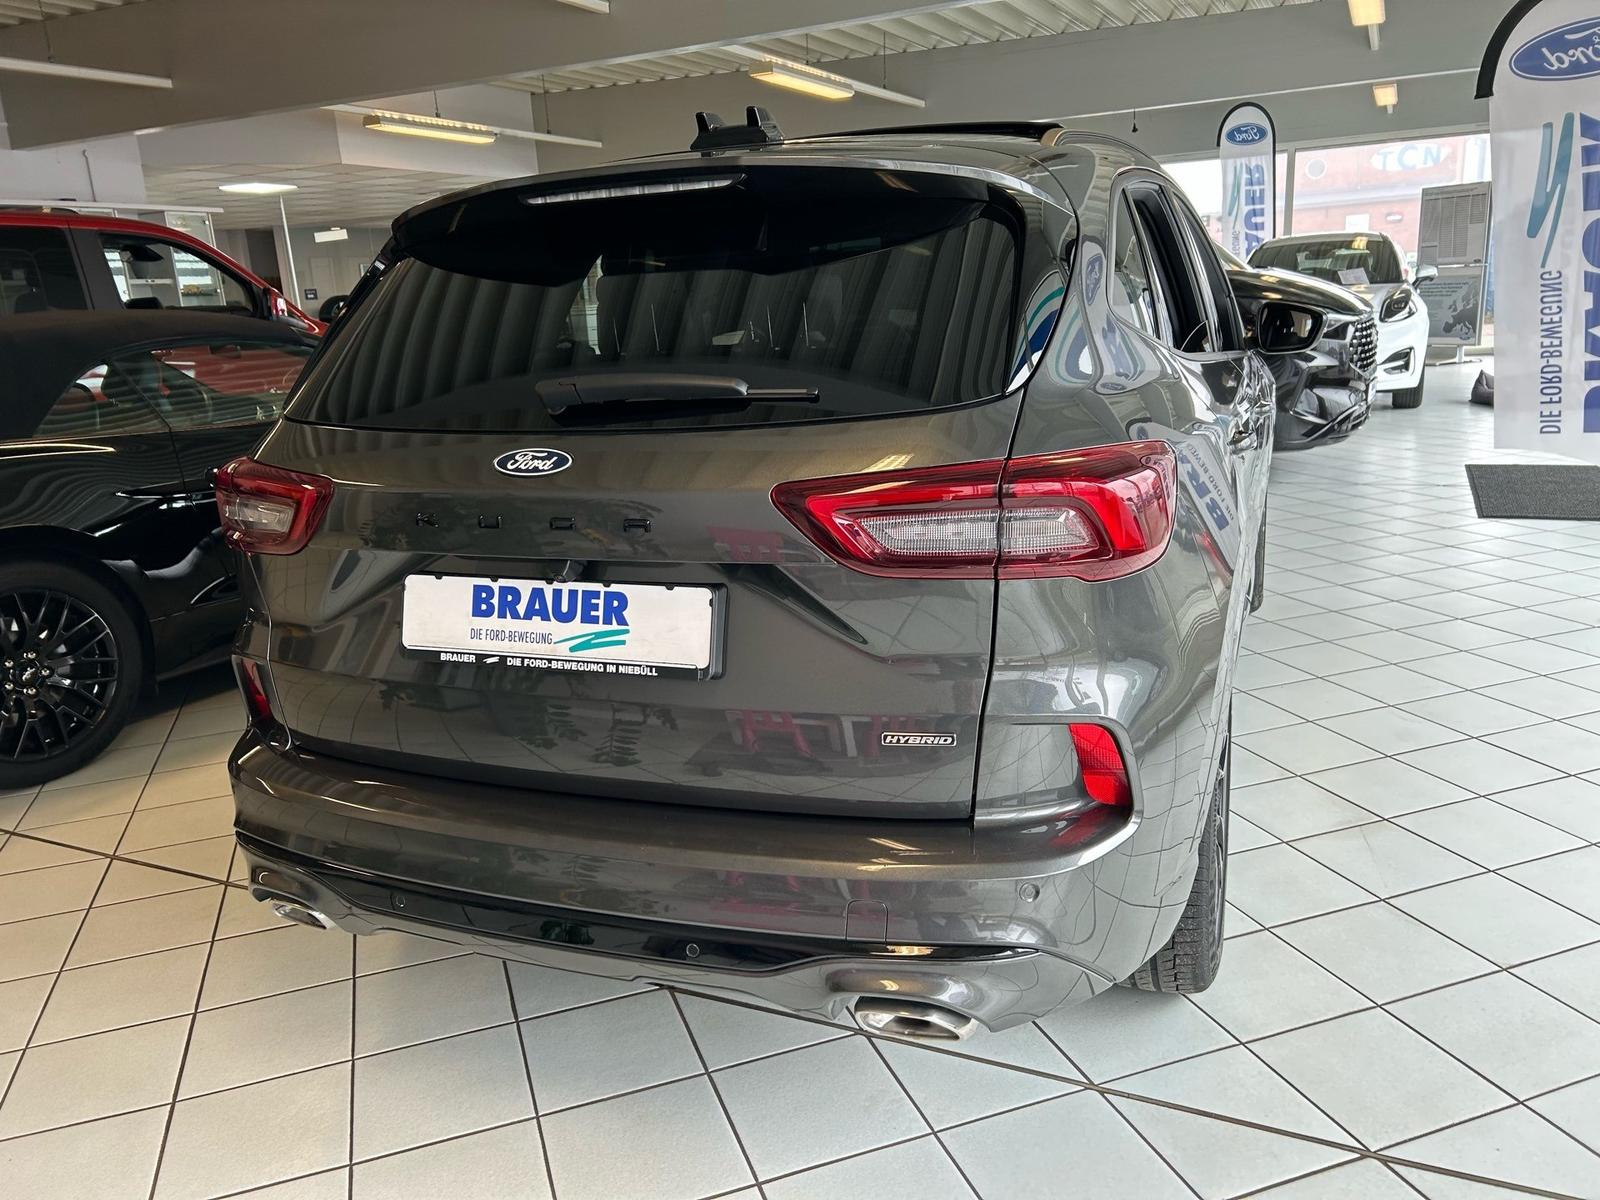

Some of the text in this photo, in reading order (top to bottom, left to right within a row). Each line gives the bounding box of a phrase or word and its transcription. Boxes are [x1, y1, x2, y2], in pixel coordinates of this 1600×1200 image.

[471, 584, 630, 627] BRAUER
[470, 627, 553, 645] DIE FORD-BEWEGUNG
[440, 652, 658, 676] BRAUER DIE FORD-BEWEGUNG IN NIEBÜLL
[885, 735, 953, 745] HYBRID
